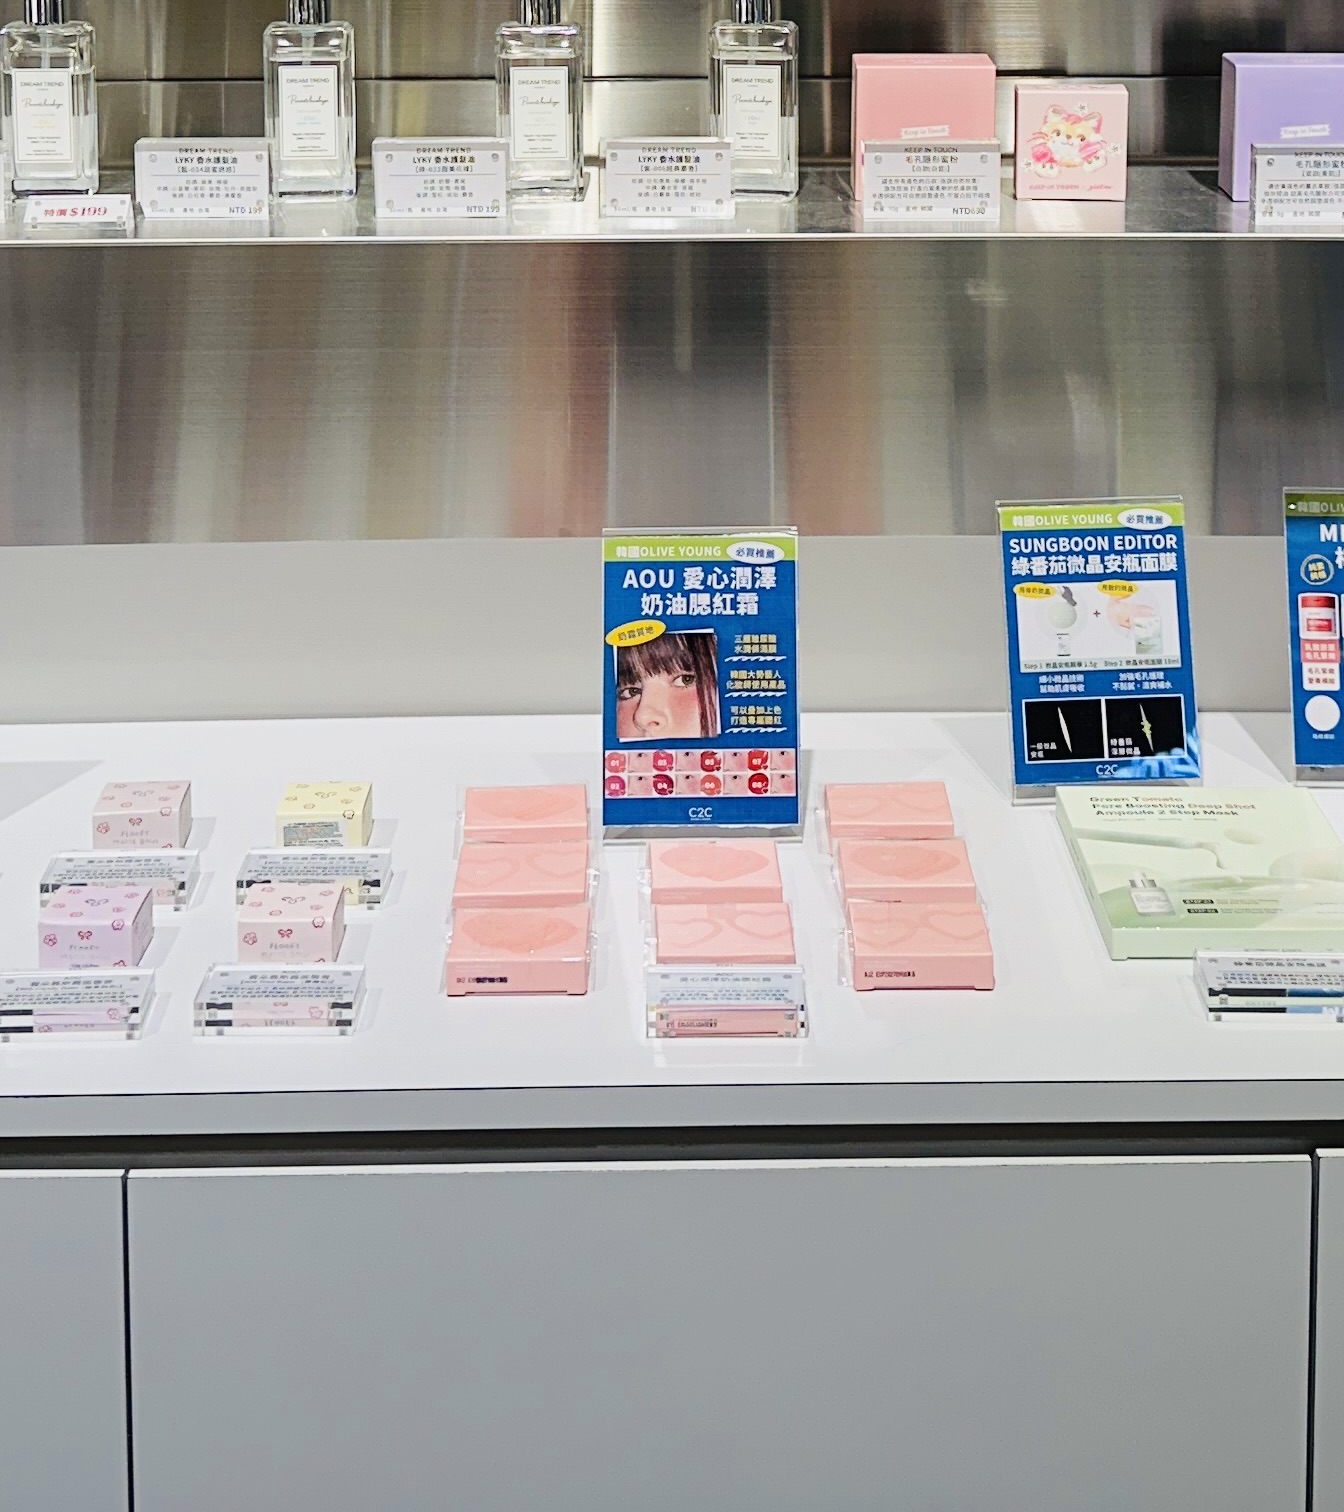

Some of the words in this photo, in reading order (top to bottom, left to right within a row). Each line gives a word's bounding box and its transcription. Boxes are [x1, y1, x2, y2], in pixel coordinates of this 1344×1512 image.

[1072, 514, 1113, 525] YOUNG
[679, 546, 721, 557] YOUNG
[1009, 536, 1110, 554] SUNGBOON
[1114, 533, 1178, 550] EDITOR
[1011, 552, 1178, 576] 綠番茄微晶安瓶面膜
[622, 568, 675, 589] AOU
[683, 566, 777, 590] 愛心潤澤
[640, 592, 759, 616] 奶油腮紅霜
[1096, 764, 1119, 776] C2C
[688, 807, 712, 818] C2C
